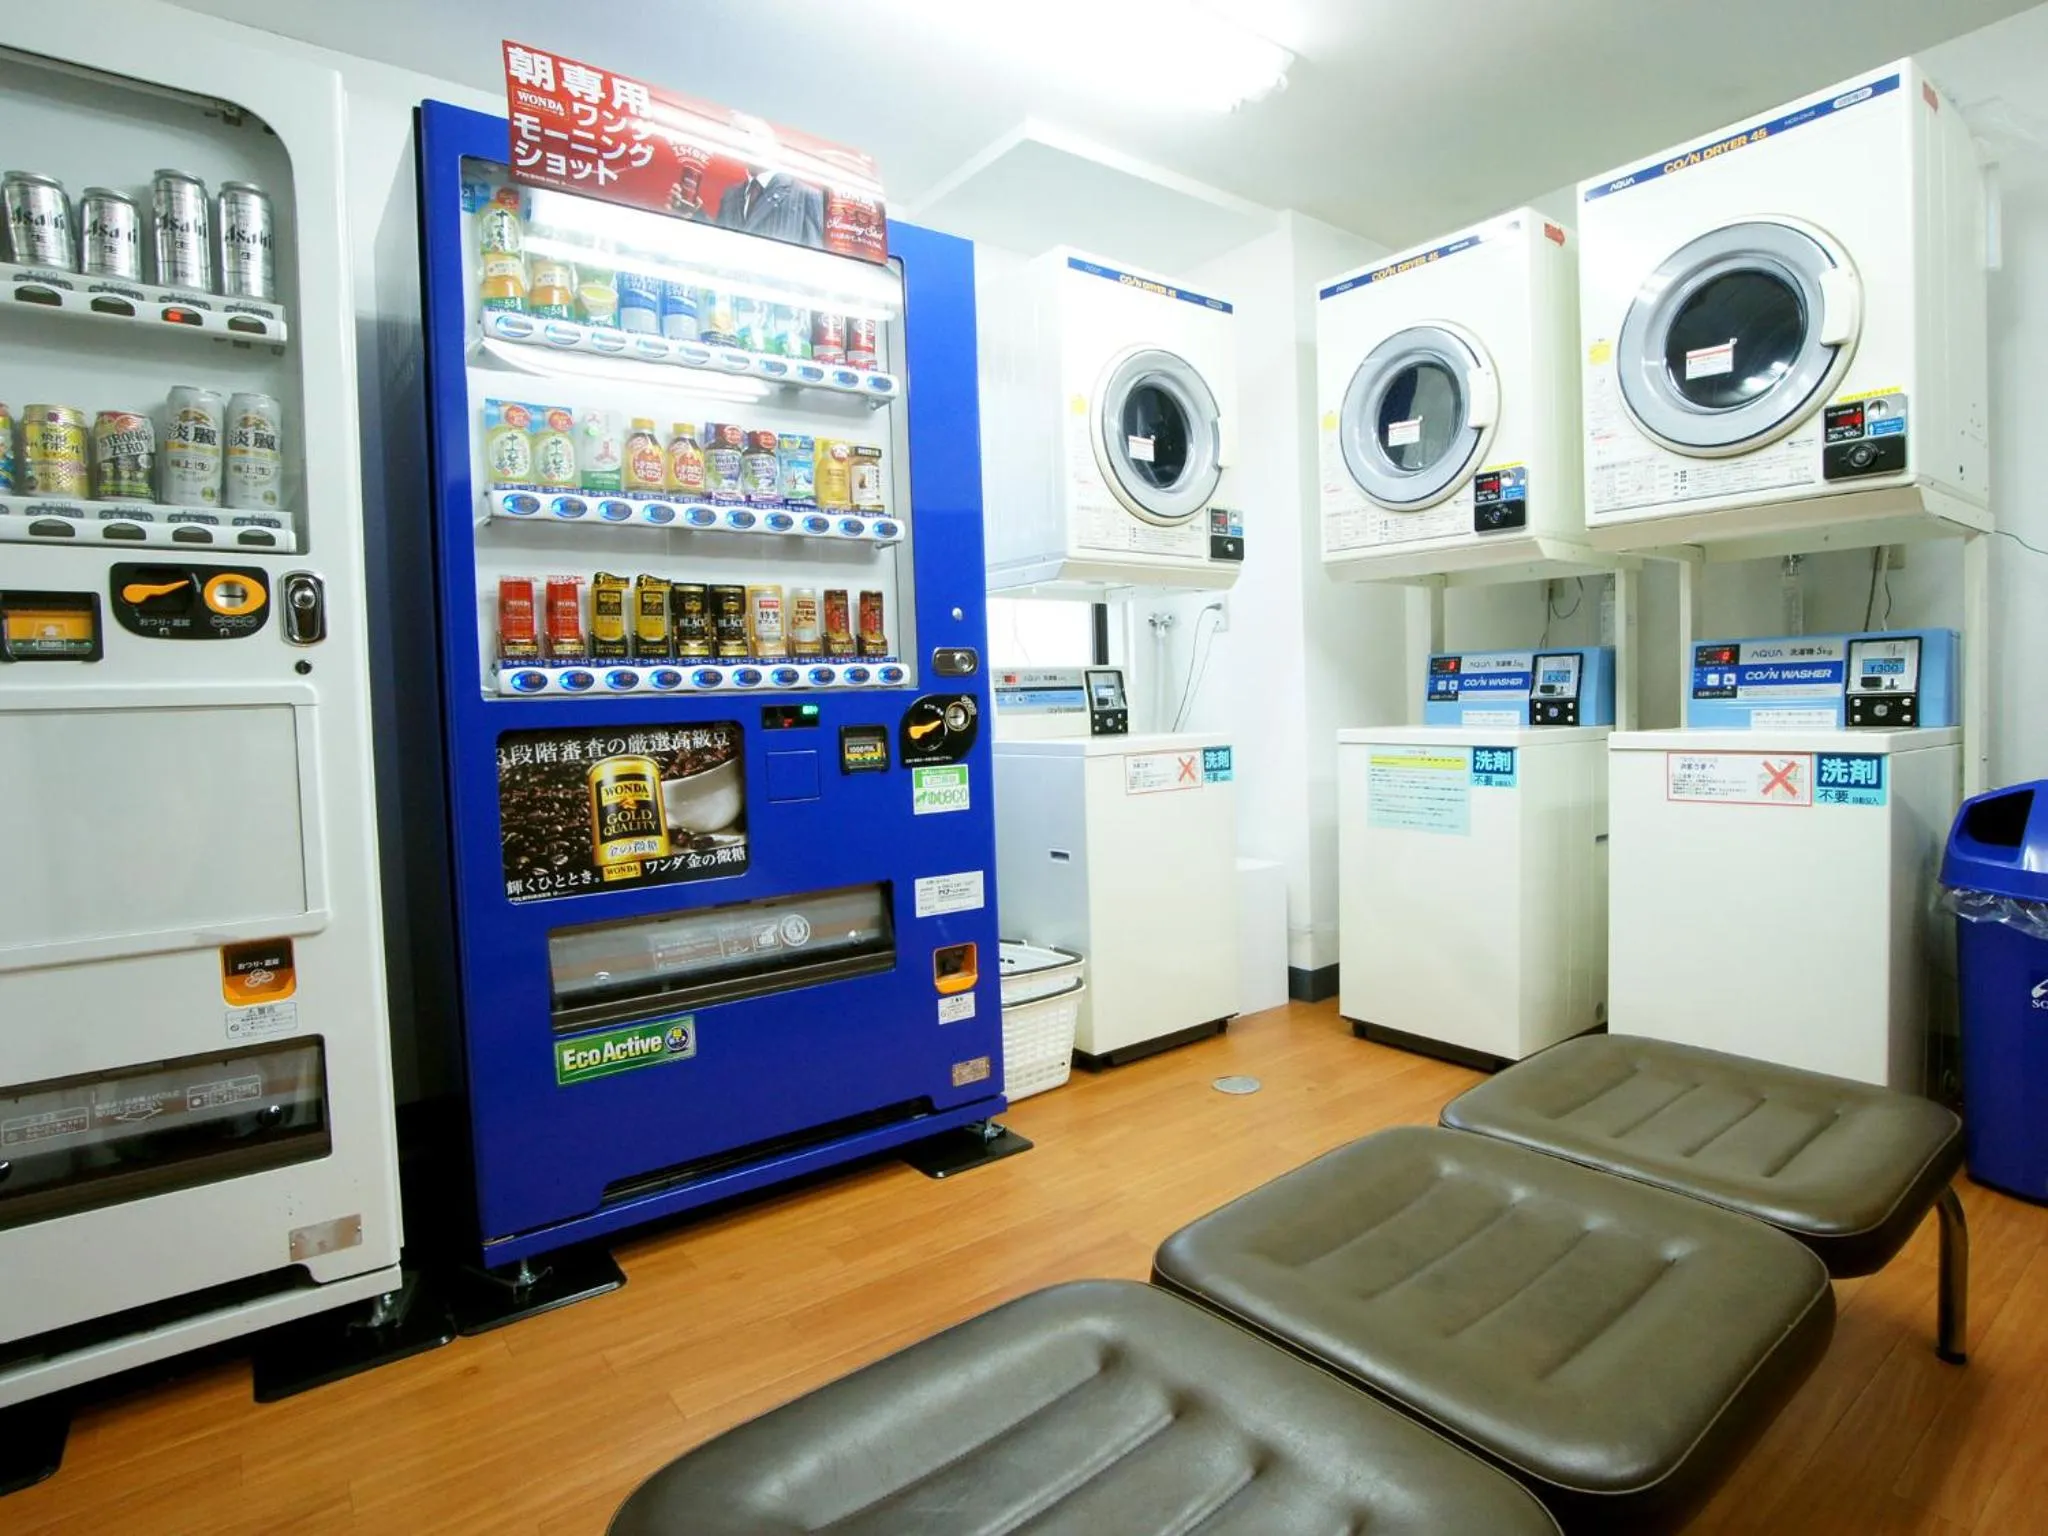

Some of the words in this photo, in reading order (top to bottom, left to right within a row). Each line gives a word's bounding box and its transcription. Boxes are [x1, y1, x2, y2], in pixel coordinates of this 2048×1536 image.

[506, 45, 652, 118] 朝専用
[517, 90, 565, 117] WONDA
[512, 111, 655, 168] モーニング
[514, 139, 619, 187] ショット
[1608, 176, 1636, 193] AQUA
[1703, 134, 1748, 161] DRYER
[1750, 127, 1768, 142] 45
[84, 219, 137, 244] Asai
[224, 224, 272, 251] Asahi
[1397, 255, 1427, 273] DRYER
[1425, 250, 1440, 262] 45
[167, 421, 217, 445] 淡麗
[229, 429, 277, 451] 淡麗
[112, 442, 145, 455] ZERO
[1751, 648, 1783, 658] AQUA
[1488, 677, 1523, 687] WASHER
[1781, 668, 1833, 680] WASHER
[496, 728, 731, 767] 3段階審査の厳選高級豆
[1205, 750, 1230, 769] 洗剤
[1475, 750, 1512, 772] 洗剤
[1821, 758, 1878, 785] 洗剤
[603, 782, 649, 797] WONDA
[1817, 789, 1849, 804] 不要
[603, 820, 657, 836] QUALITY
[606, 809, 653, 825] GOLD
[606, 863, 639, 876] WONDA
